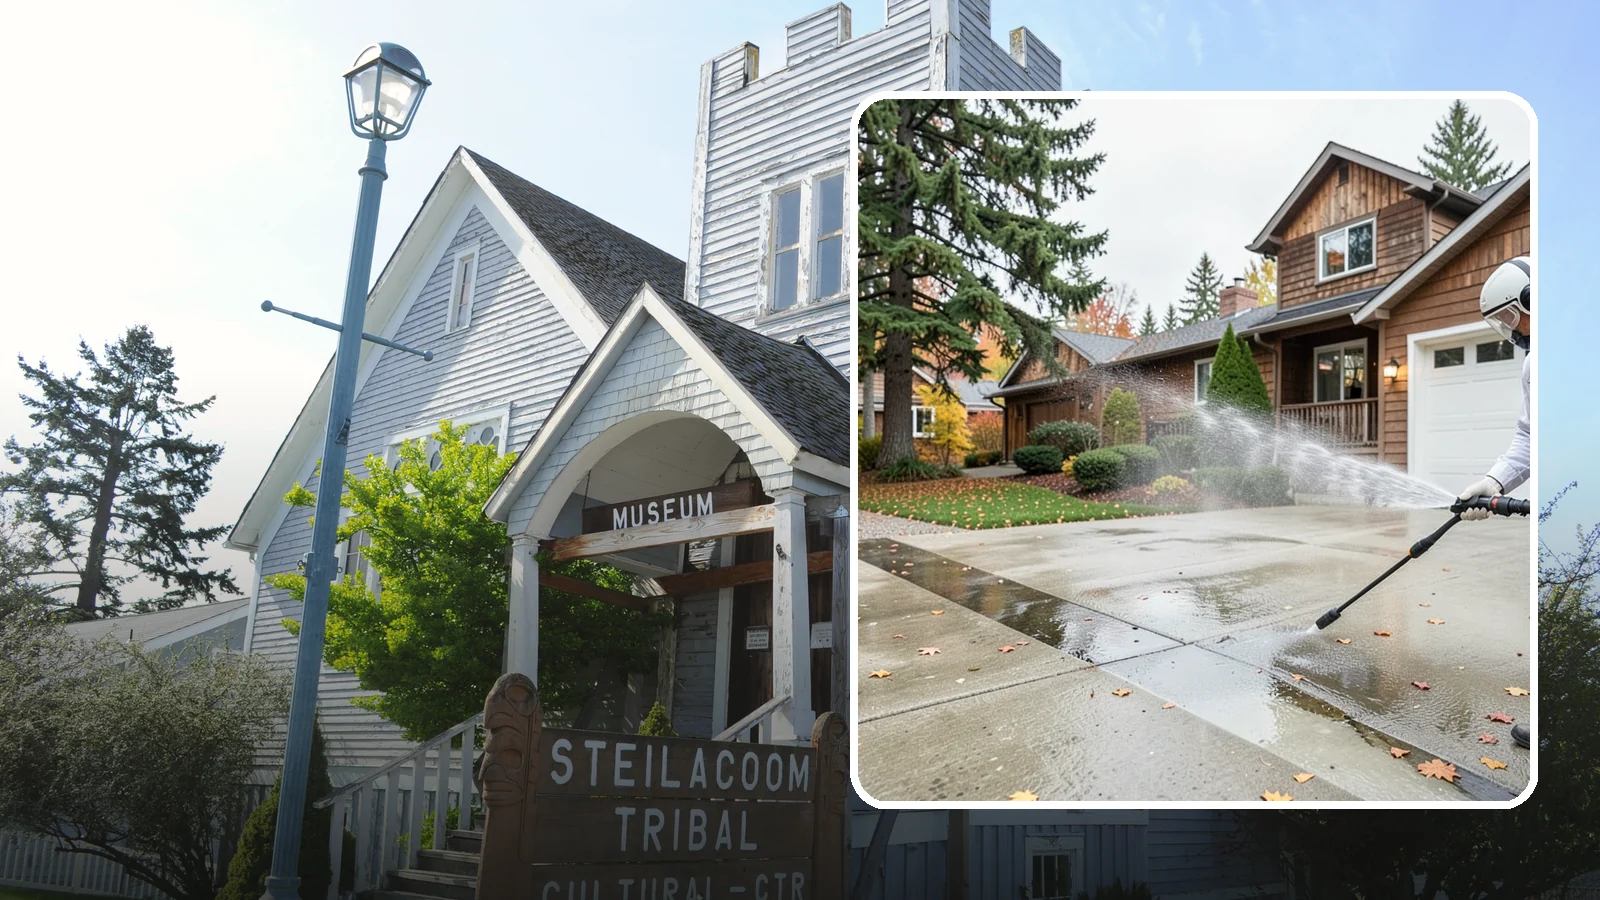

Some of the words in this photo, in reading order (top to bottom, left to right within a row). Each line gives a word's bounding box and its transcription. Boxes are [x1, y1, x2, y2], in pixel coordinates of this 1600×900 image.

[613, 491, 713, 530] MUSEUM
[551, 738, 809, 792] STEILACOOM
[615, 807, 757, 851] TRIBAL
